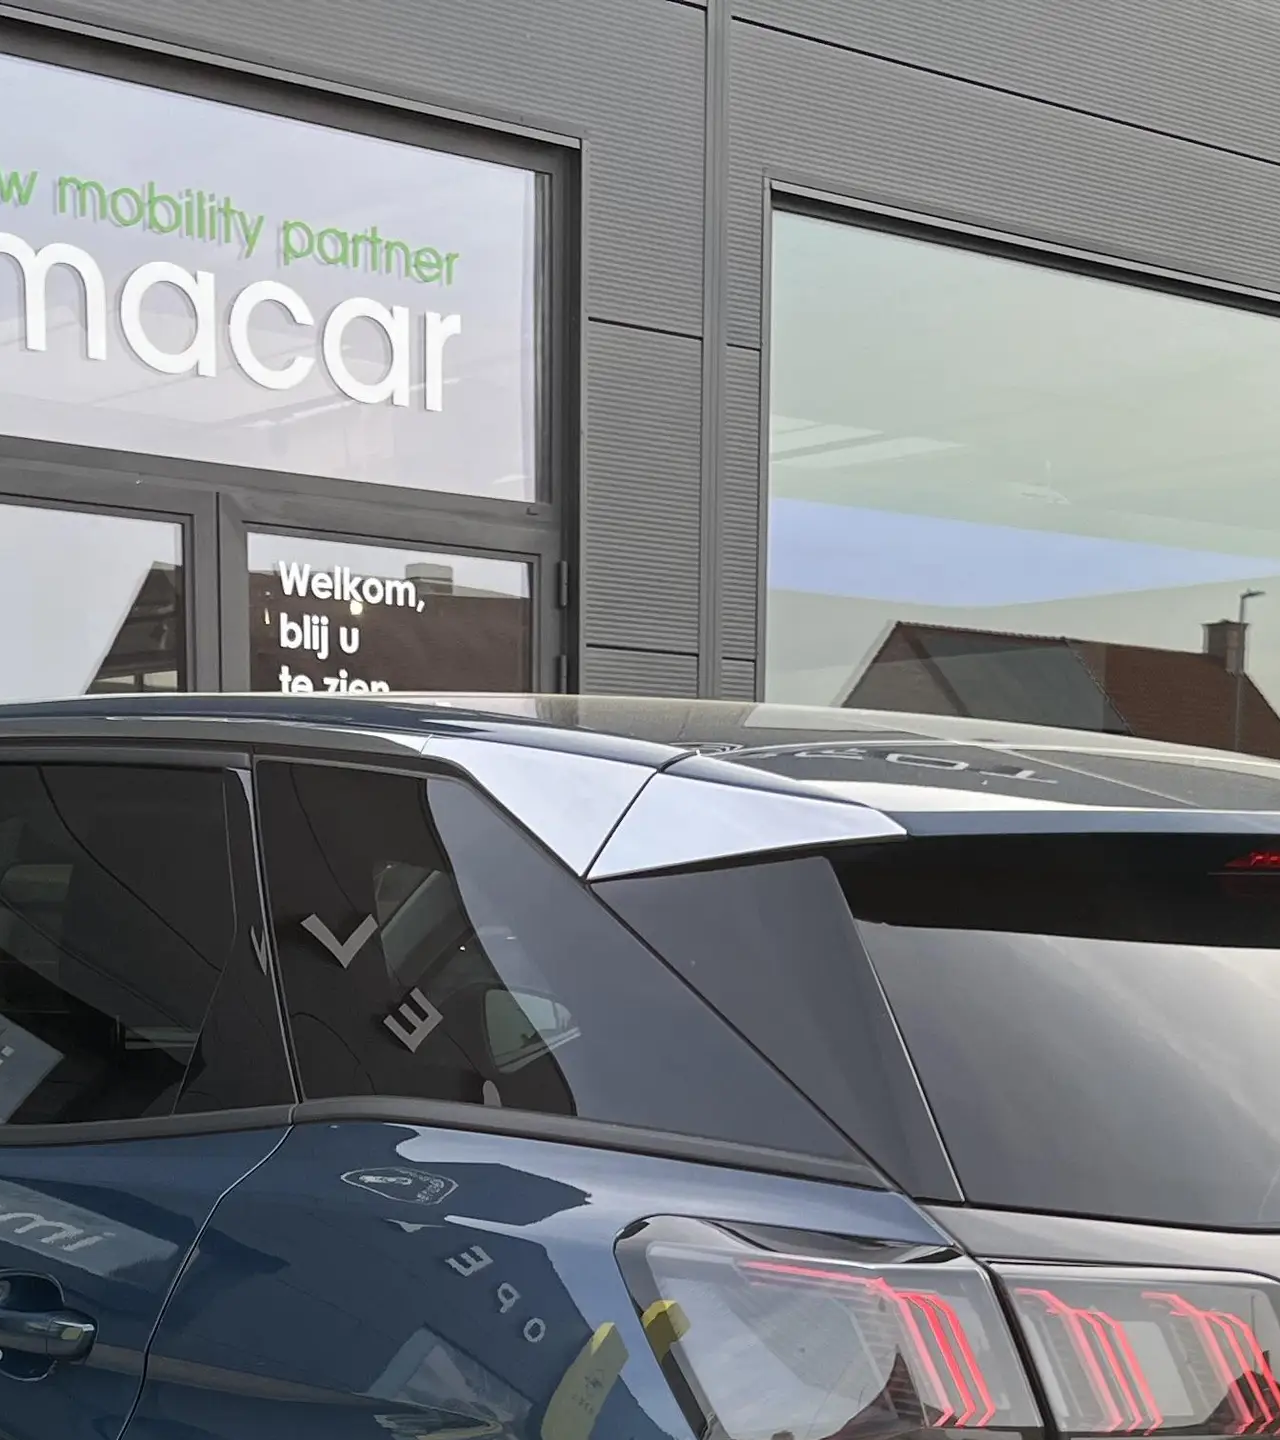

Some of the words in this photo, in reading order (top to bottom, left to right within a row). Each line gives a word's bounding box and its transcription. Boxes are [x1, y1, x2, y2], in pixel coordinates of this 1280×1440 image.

[58, 174, 265, 258] mobility
[281, 218, 460, 286] partner
[278, 561, 425, 613] Welkom,
[279, 612, 330, 660] blij
[339, 626, 360, 654] u
